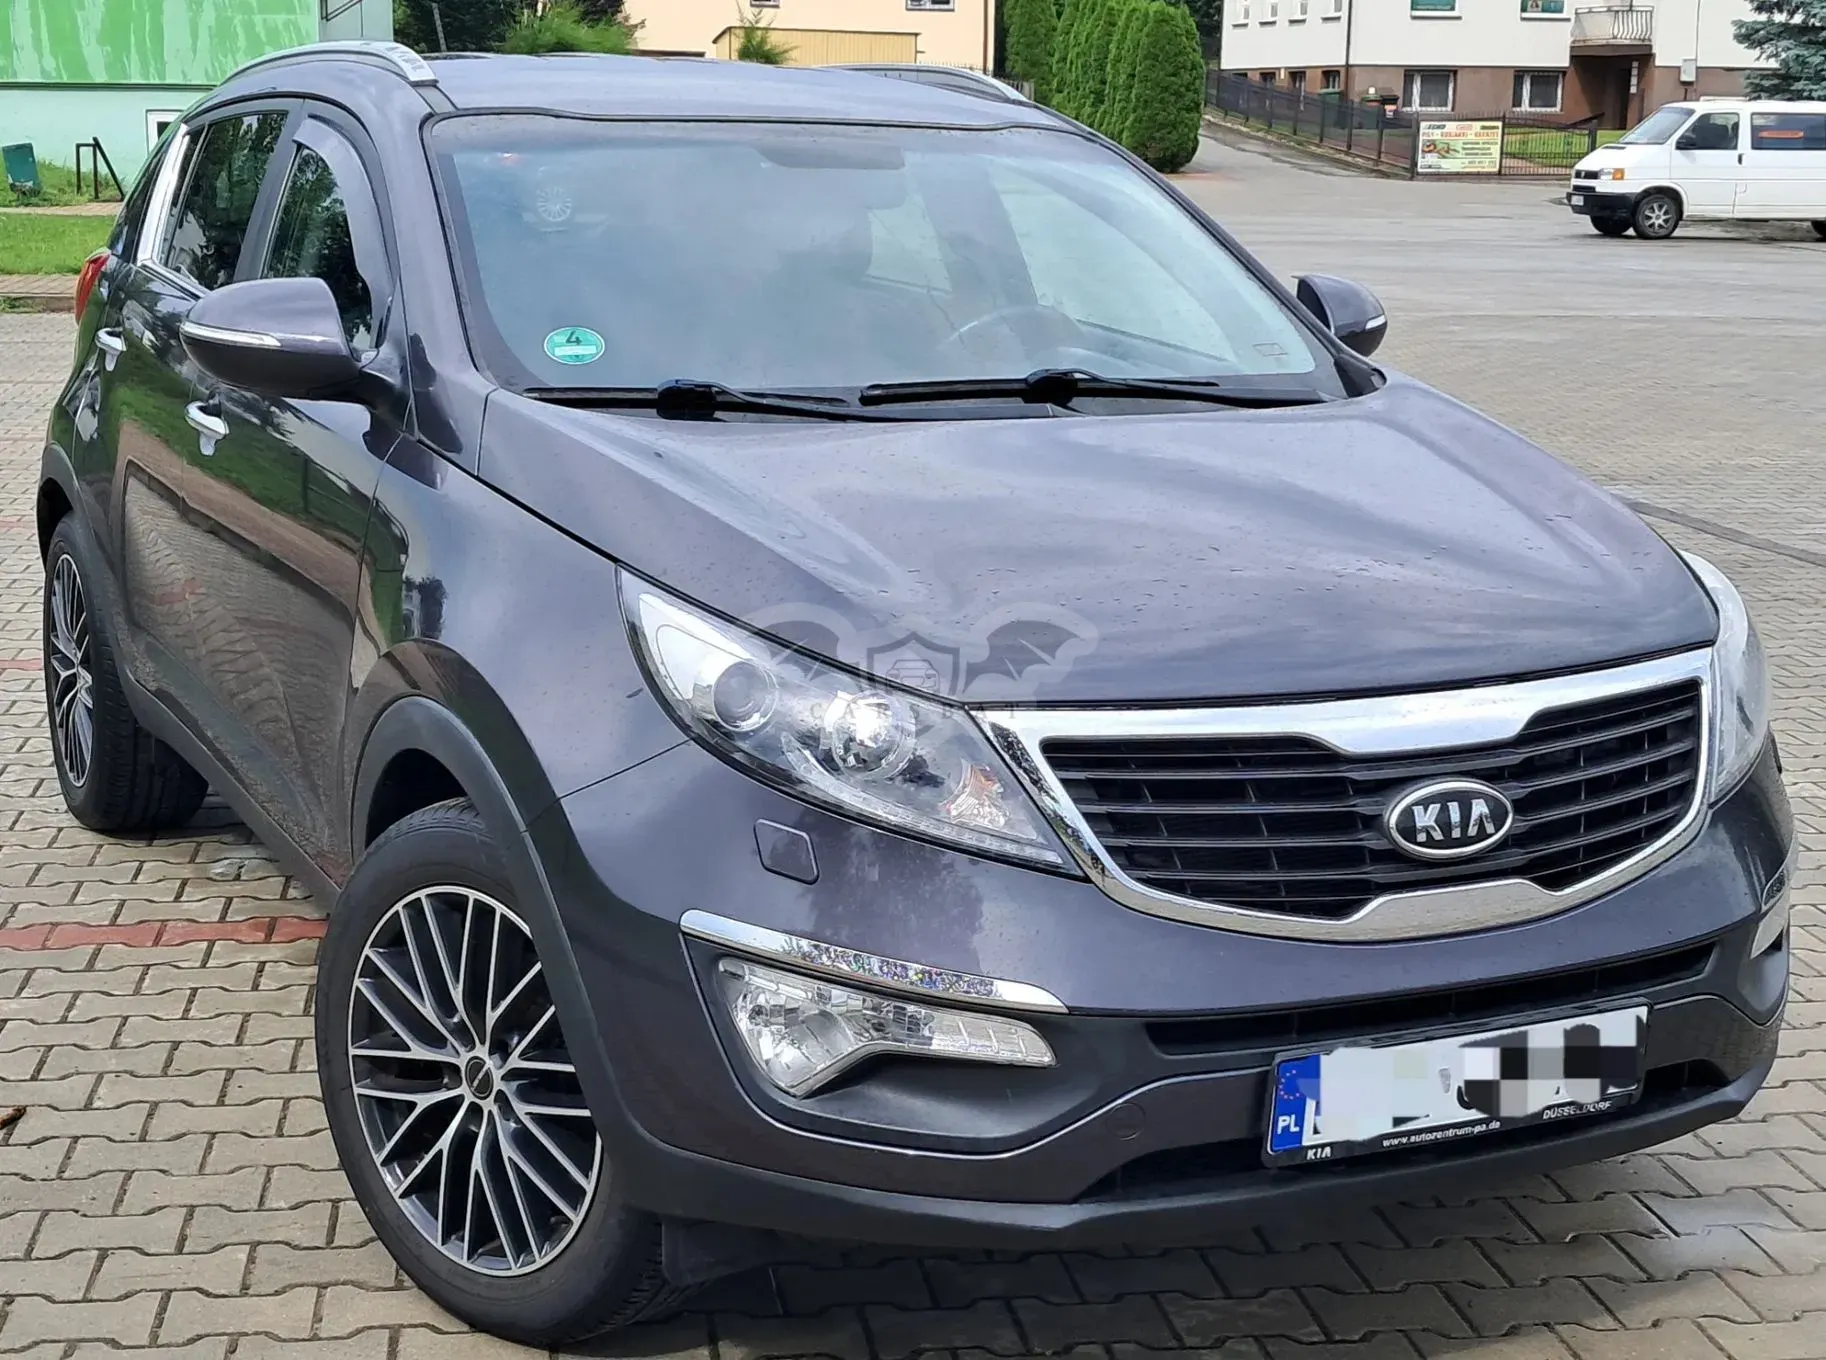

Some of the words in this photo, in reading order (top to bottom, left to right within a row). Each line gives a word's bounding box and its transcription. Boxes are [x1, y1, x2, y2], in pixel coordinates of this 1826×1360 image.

[565, 330, 583, 346] 4
[1411, 798, 1496, 843] KIA
[1276, 1114, 1300, 1135] PL
[1306, 1146, 1331, 1161] KIA
